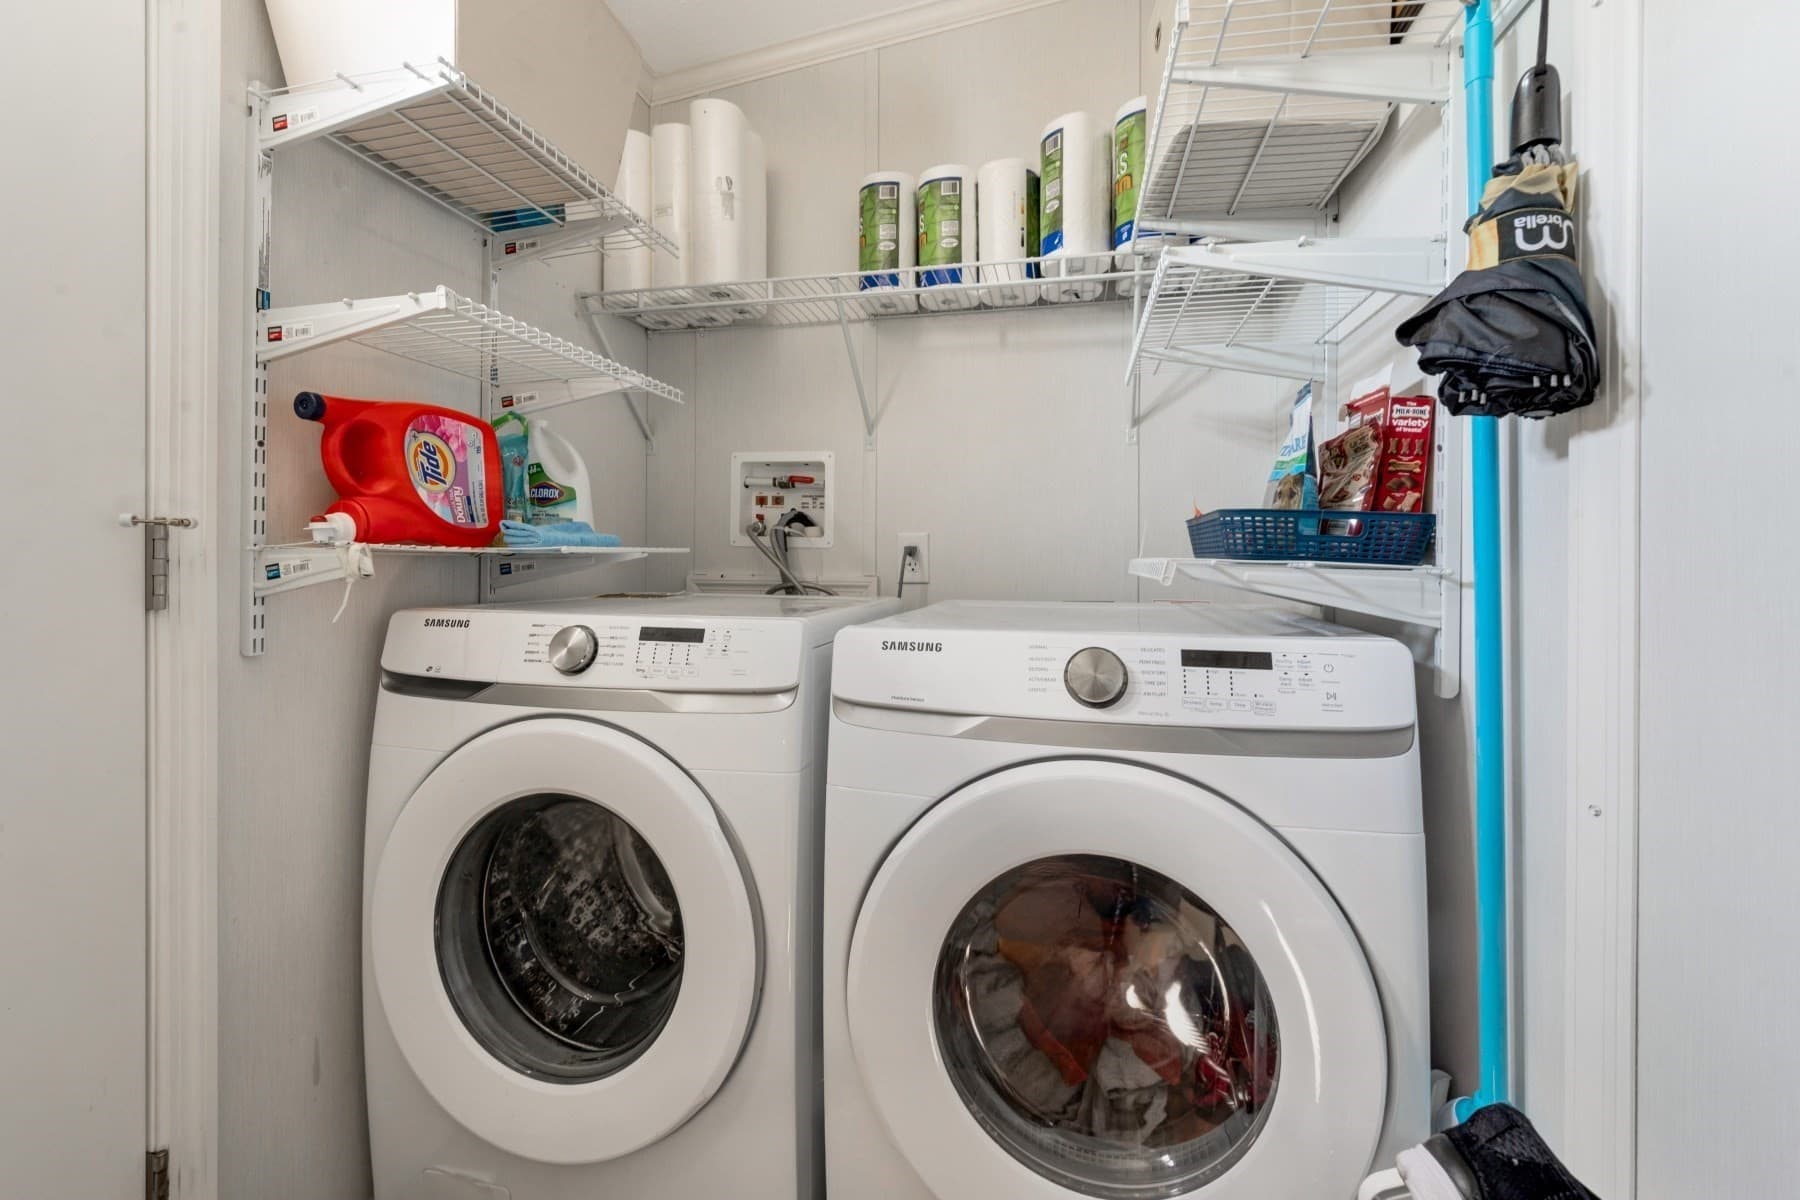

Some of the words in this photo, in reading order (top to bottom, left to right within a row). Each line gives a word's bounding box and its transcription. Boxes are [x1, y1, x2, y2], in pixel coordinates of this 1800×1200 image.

[1392, 418, 1429, 429] variety
[420, 440, 448, 485] Tide
[530, 487, 560, 499] CLOROX
[453, 486, 466, 523] Downy
[424, 618, 471, 628] SAMSUNG
[881, 640, 943, 652] SAMSUNG
